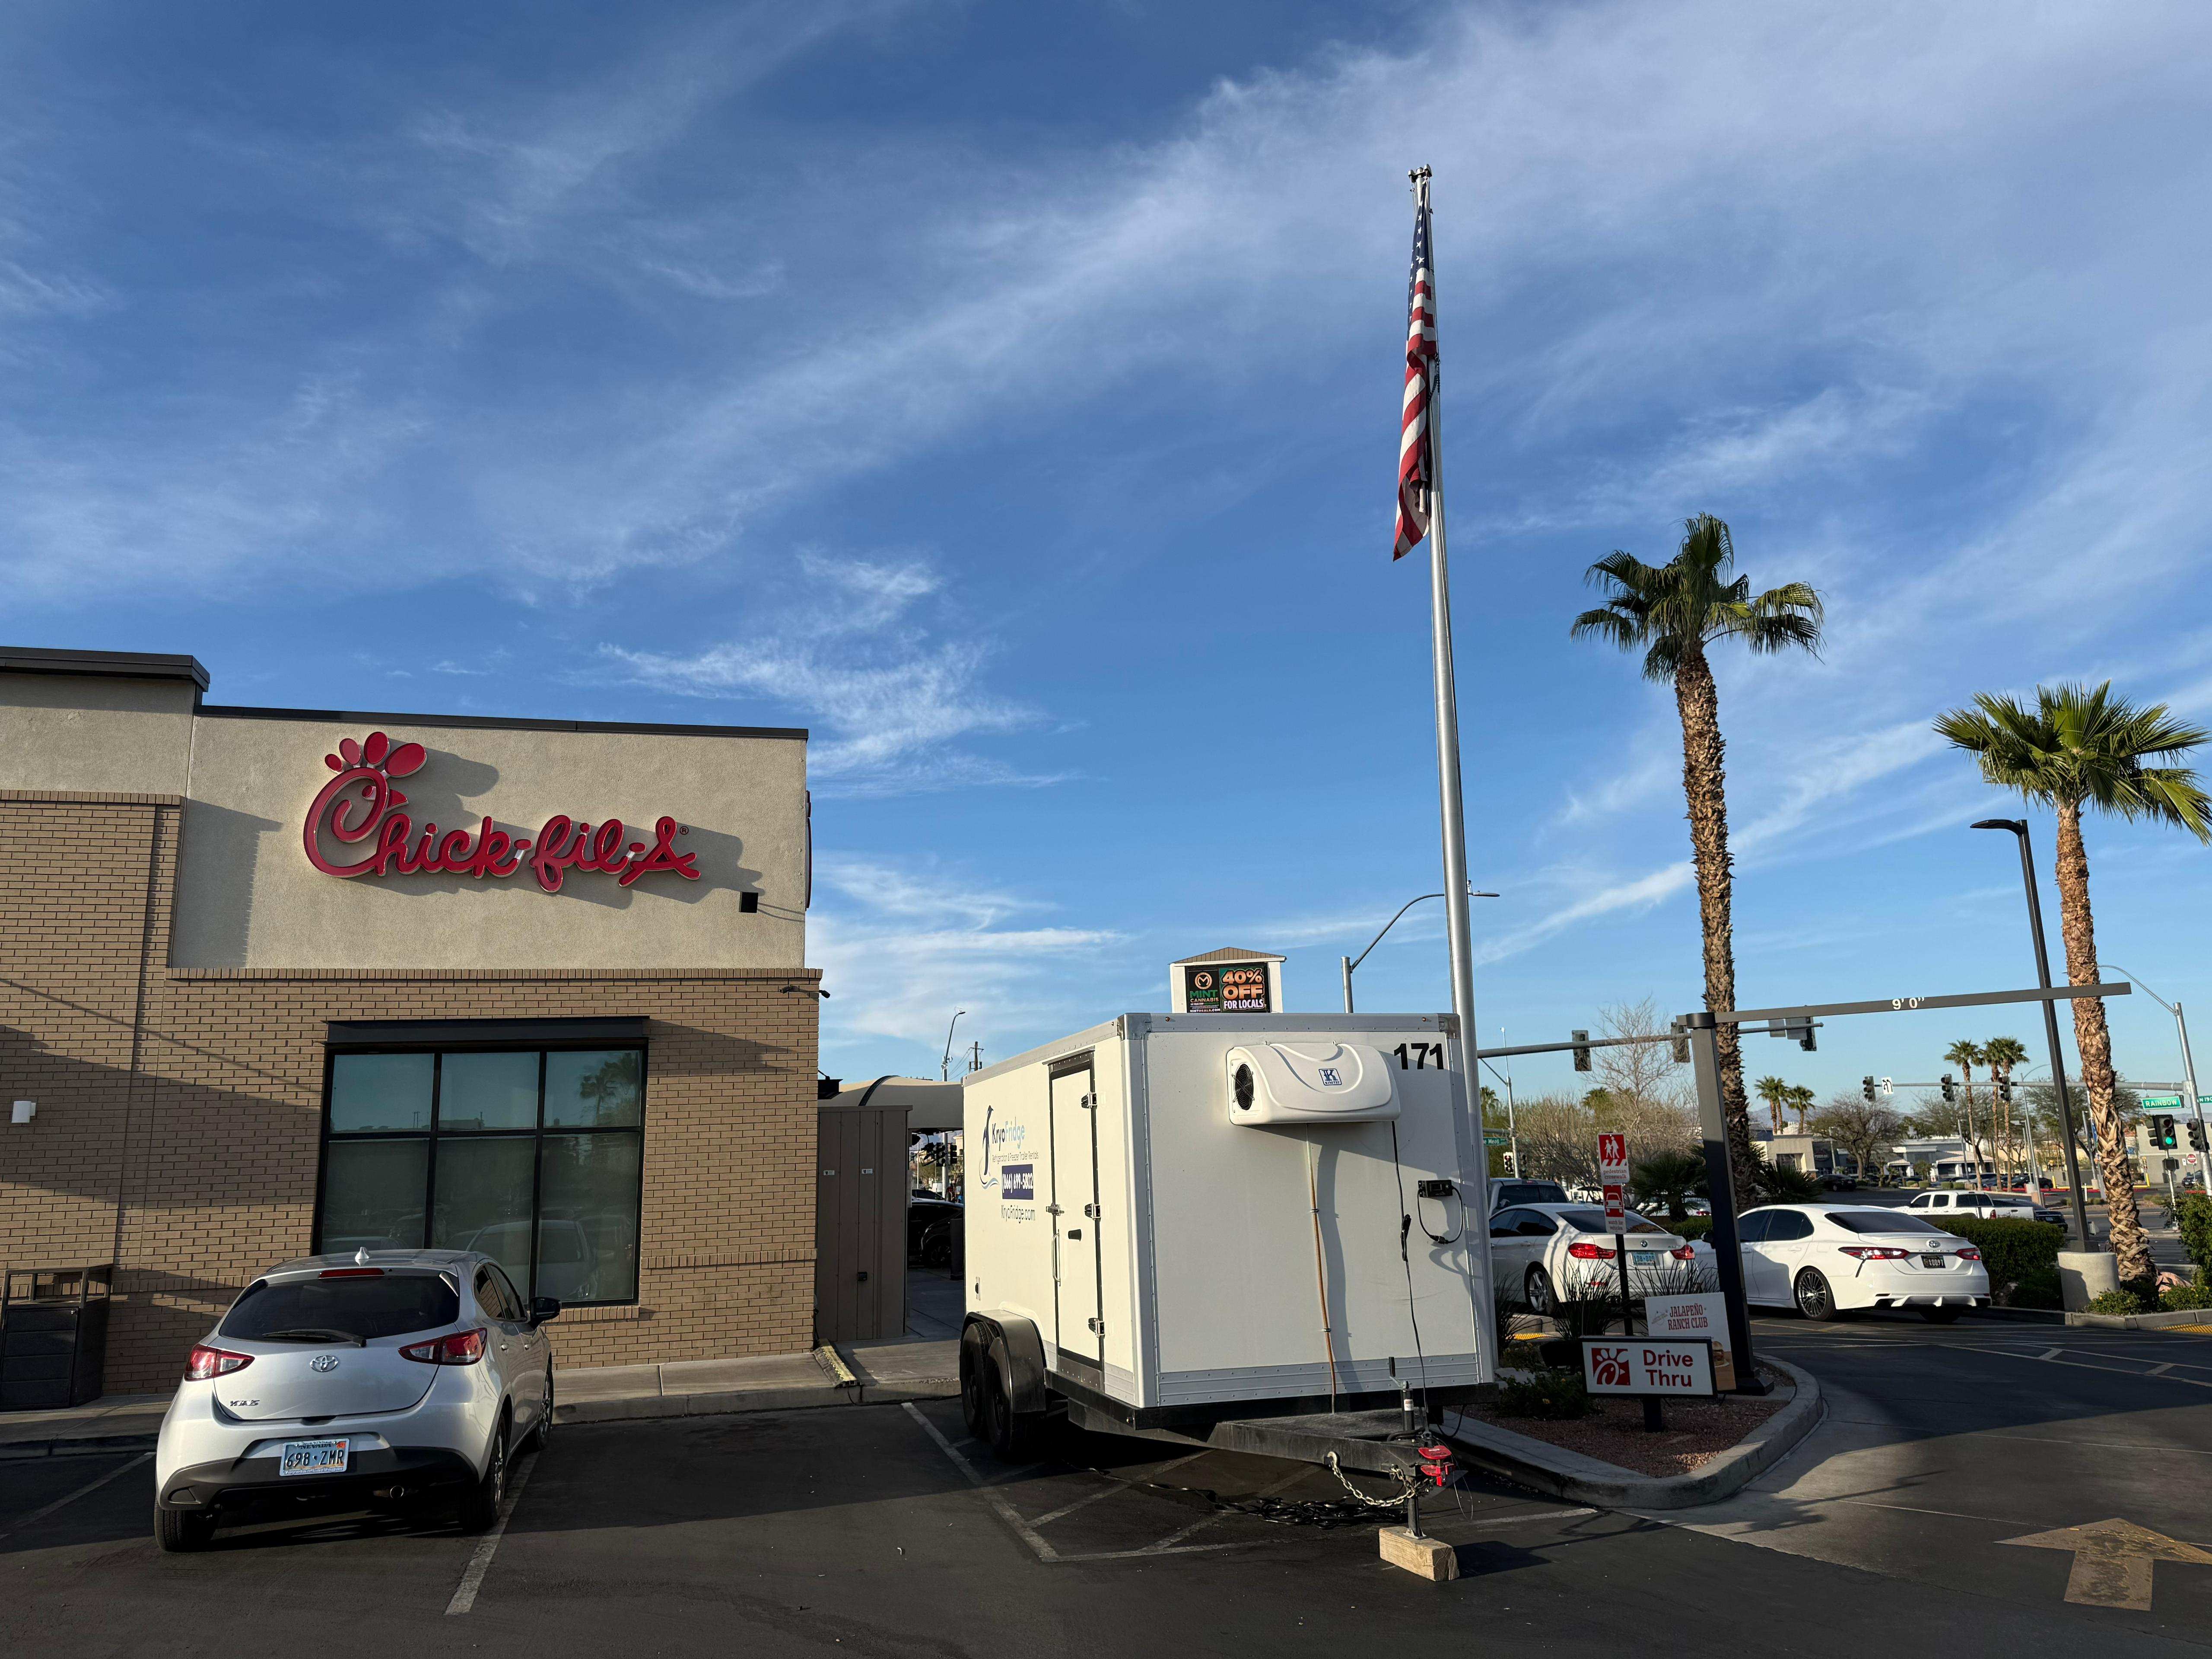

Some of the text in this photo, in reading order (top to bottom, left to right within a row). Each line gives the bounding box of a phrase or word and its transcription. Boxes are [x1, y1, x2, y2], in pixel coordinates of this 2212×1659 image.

[303, 752, 701, 893] Chick-fil-A
[1223, 969, 1262, 984] 40%
[1190, 990, 1217, 998] MINT
[1223, 984, 1263, 999] OFF
[1224, 999, 1264, 1009] FOR LOCALS
[1394, 1043, 1444, 1070] 171
[992, 1116, 1025, 1151] KryoFridge
[1001, 1205, 1036, 1224] KryoFridge.com
[1670, 1303, 1703, 1317] JALAPEÑO
[1668, 1317, 1708, 1330] RANCH CLUB
[1643, 1350, 1693, 1367] Drive
[1646, 1369, 1692, 1387] Thru
